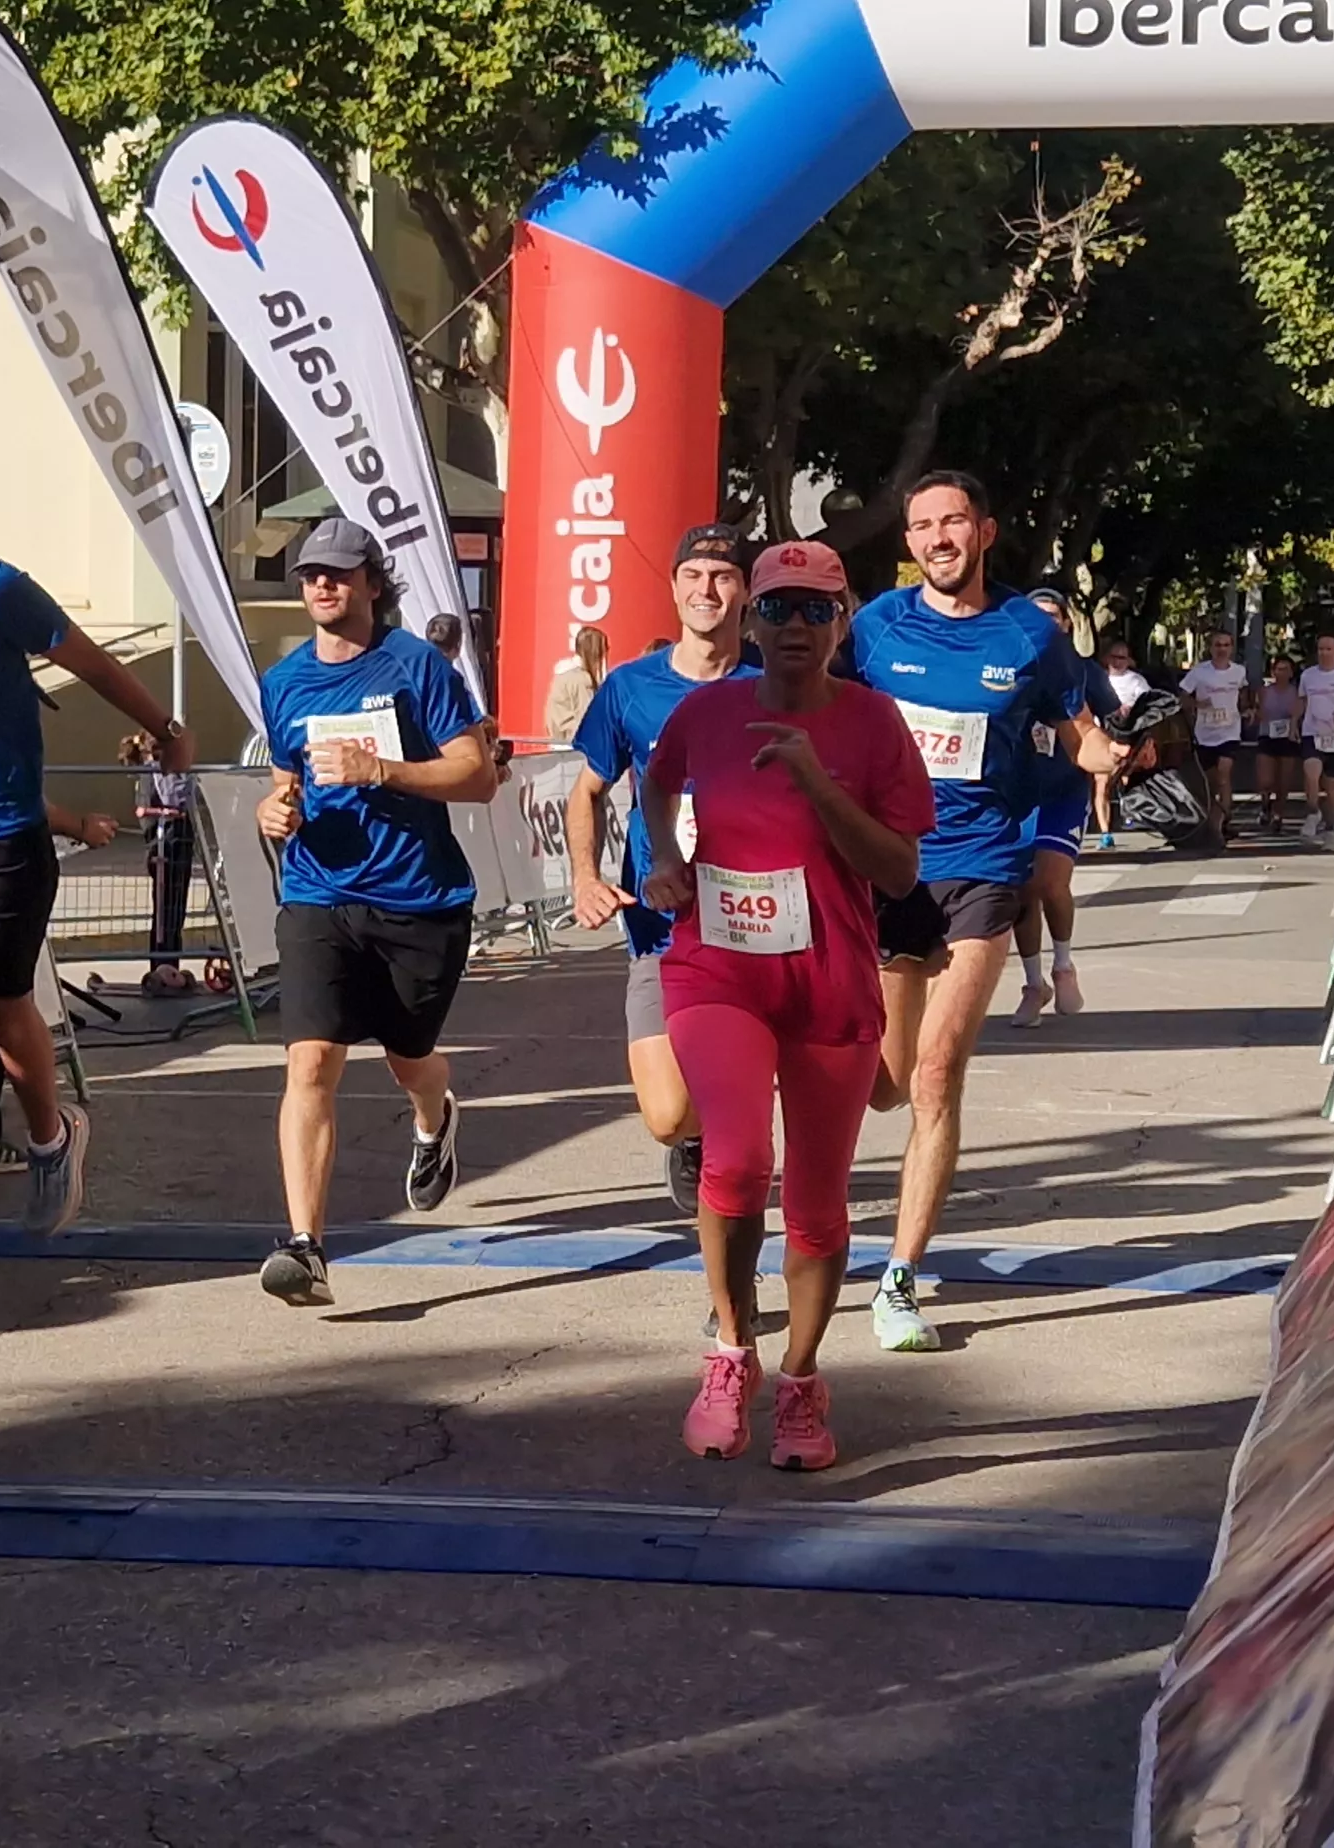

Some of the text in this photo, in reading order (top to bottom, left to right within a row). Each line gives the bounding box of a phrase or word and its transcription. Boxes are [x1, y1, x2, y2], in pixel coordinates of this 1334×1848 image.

[982, 664, 1016, 682] aws
[361, 694, 395, 709] aws
[912, 729, 962, 754] 378
[719, 891, 777, 919] 549
[727, 919, 772, 933] MARIA
